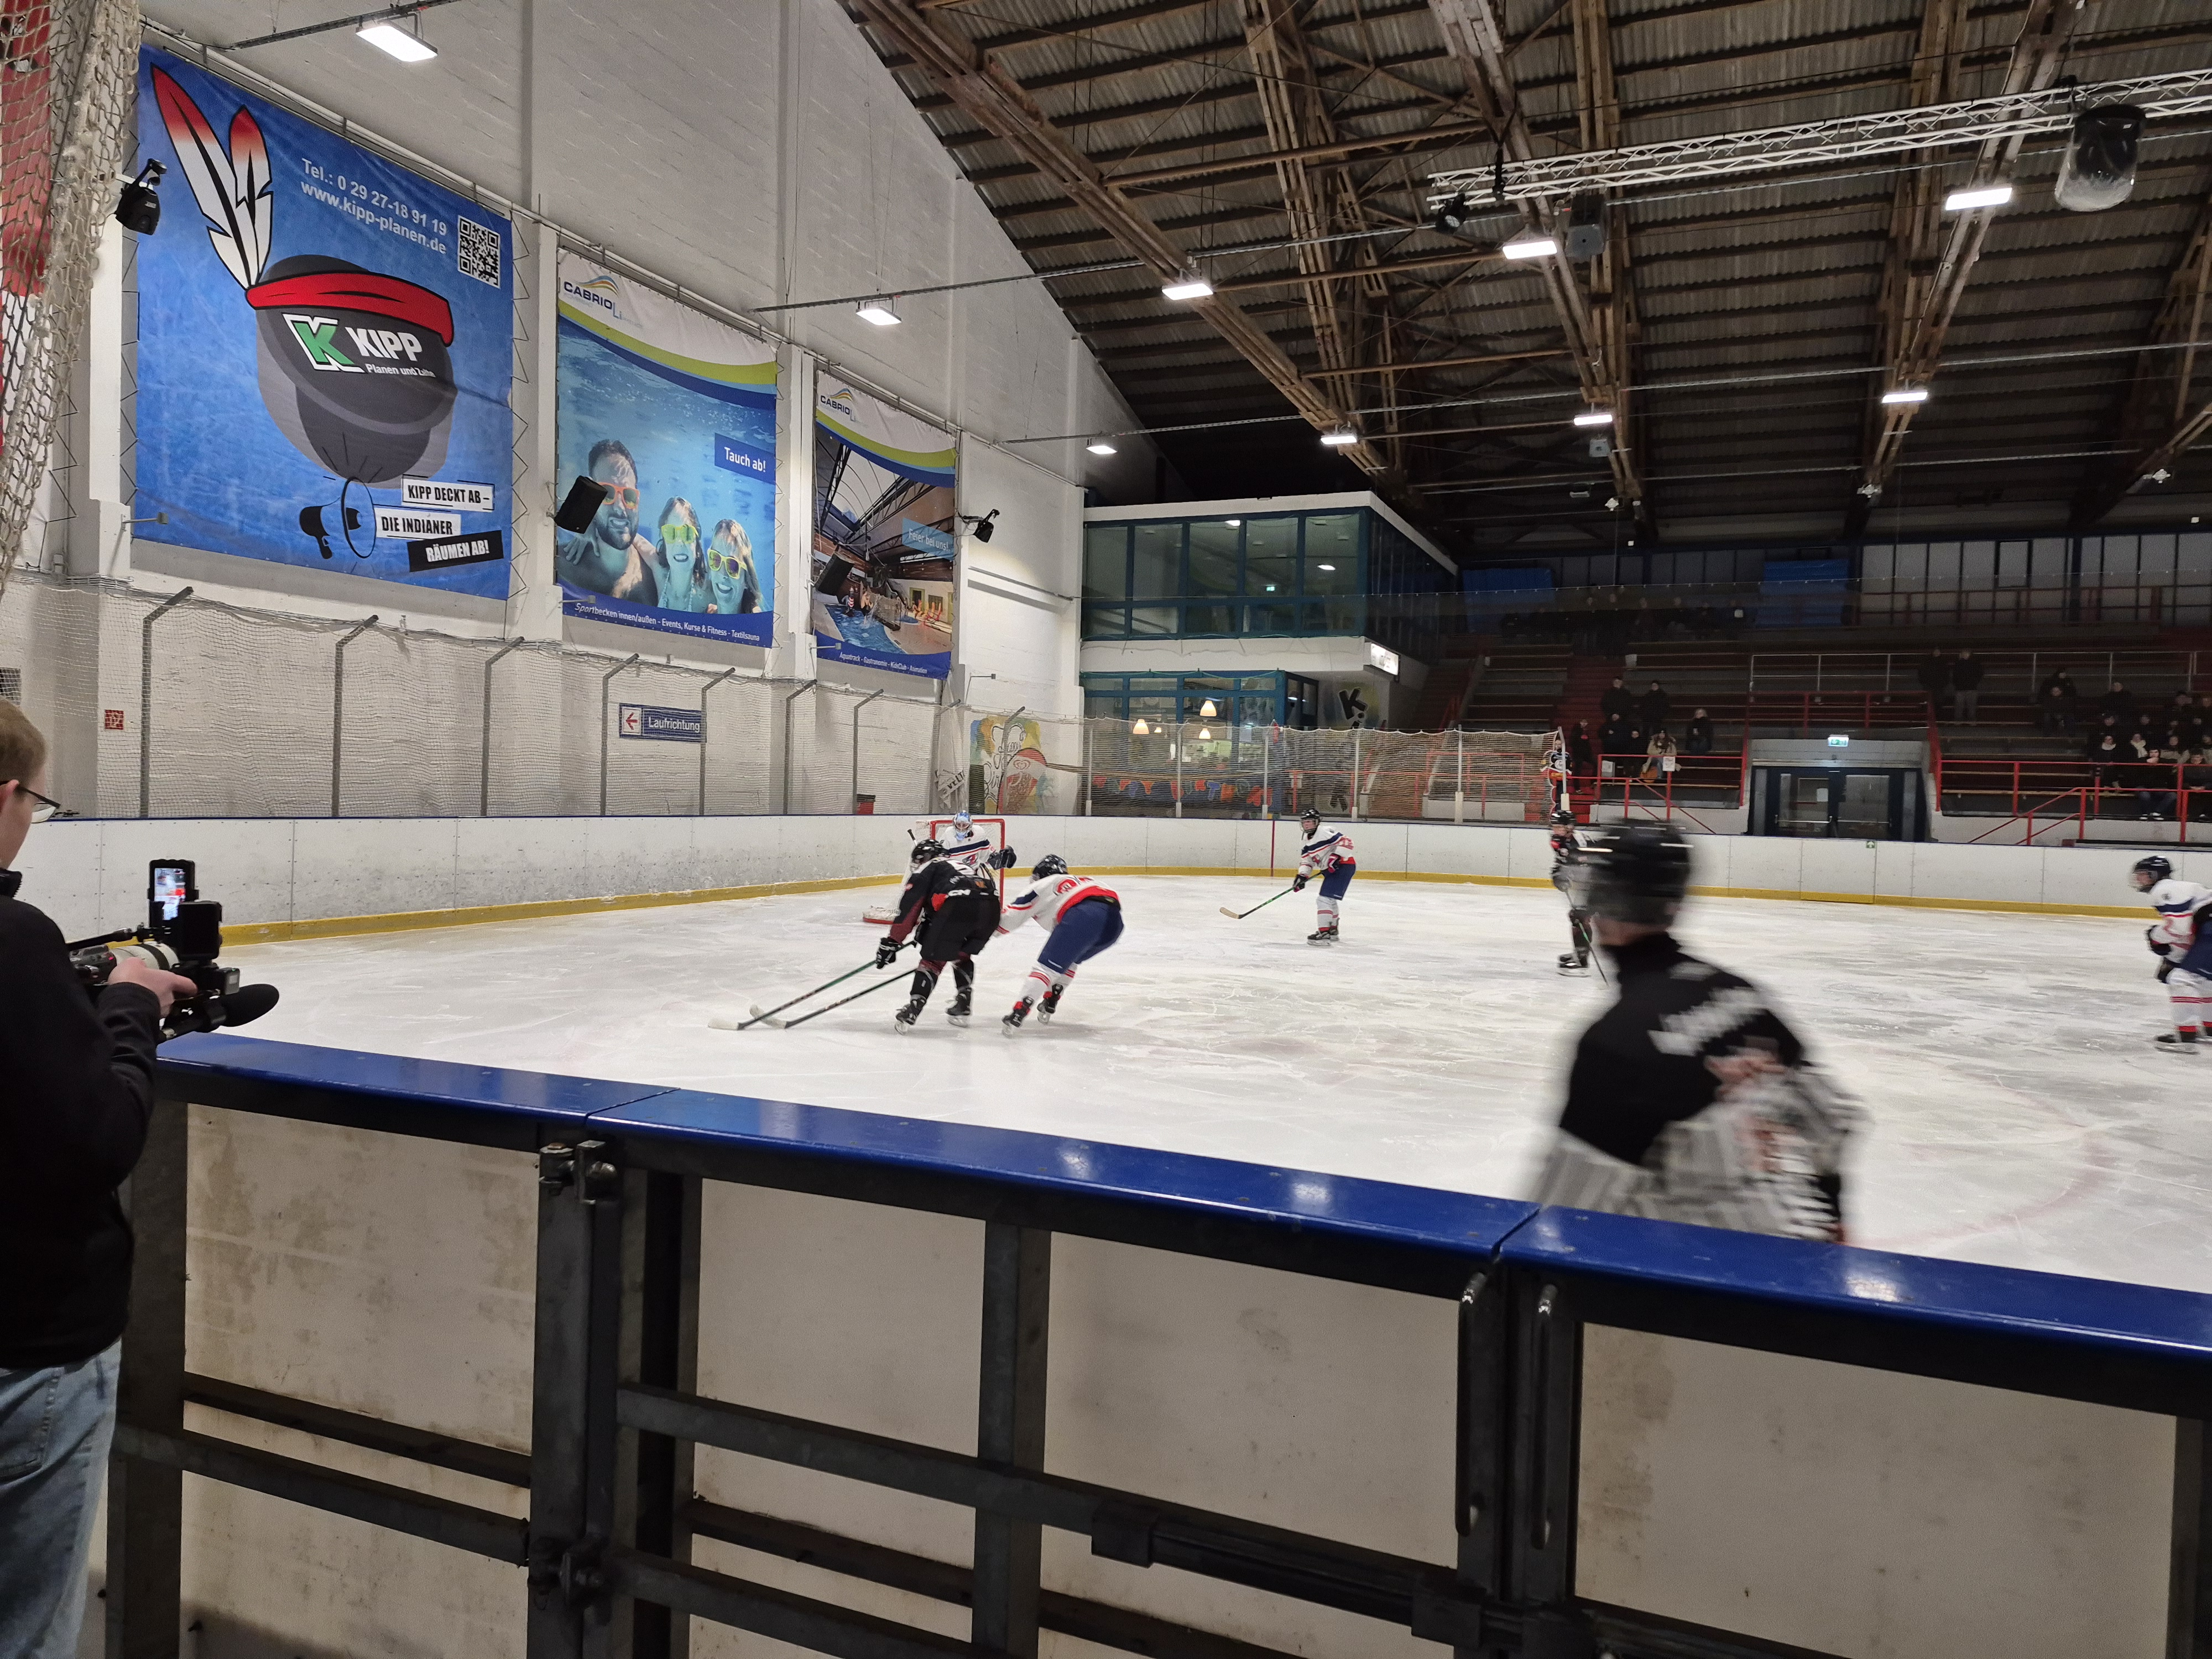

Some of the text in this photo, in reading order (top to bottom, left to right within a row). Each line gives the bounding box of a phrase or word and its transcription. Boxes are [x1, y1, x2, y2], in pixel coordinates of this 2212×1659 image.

[302, 158, 447, 236] Tel.: 0 29 27-18 91 19
[301, 181, 447, 254] www.kipp-planen.de
[564, 281, 613, 310] CABRIO
[345, 326, 422, 362] KIPP
[365, 363, 399, 375] Planen
[399, 367, 418, 375] und
[820, 395, 851, 415] CABRIO
[724, 446, 766, 473] Tauch ab!
[408, 485, 431, 500] KIPP
[434, 487, 466, 503] DECKT
[468, 489, 481, 504] AB
[381, 517, 453, 535] DIE INDIANER
[909, 528, 949, 551] Feier bei uns!
[425, 540, 490, 563] RÄUMEN AB!
[575, 603, 618, 618] Sportbecken
[618, 611, 656, 624] innen/außen
[662, 618, 683, 630] Events,
[684, 622, 701, 632] Kurse
[707, 625, 727, 636] Fitness
[731, 629, 760, 641] Textilsauna
[839, 651, 860, 662] Aquatrack
[864, 656, 888, 667] Gastronomie
[649, 716, 700, 733] Laufrichtung
